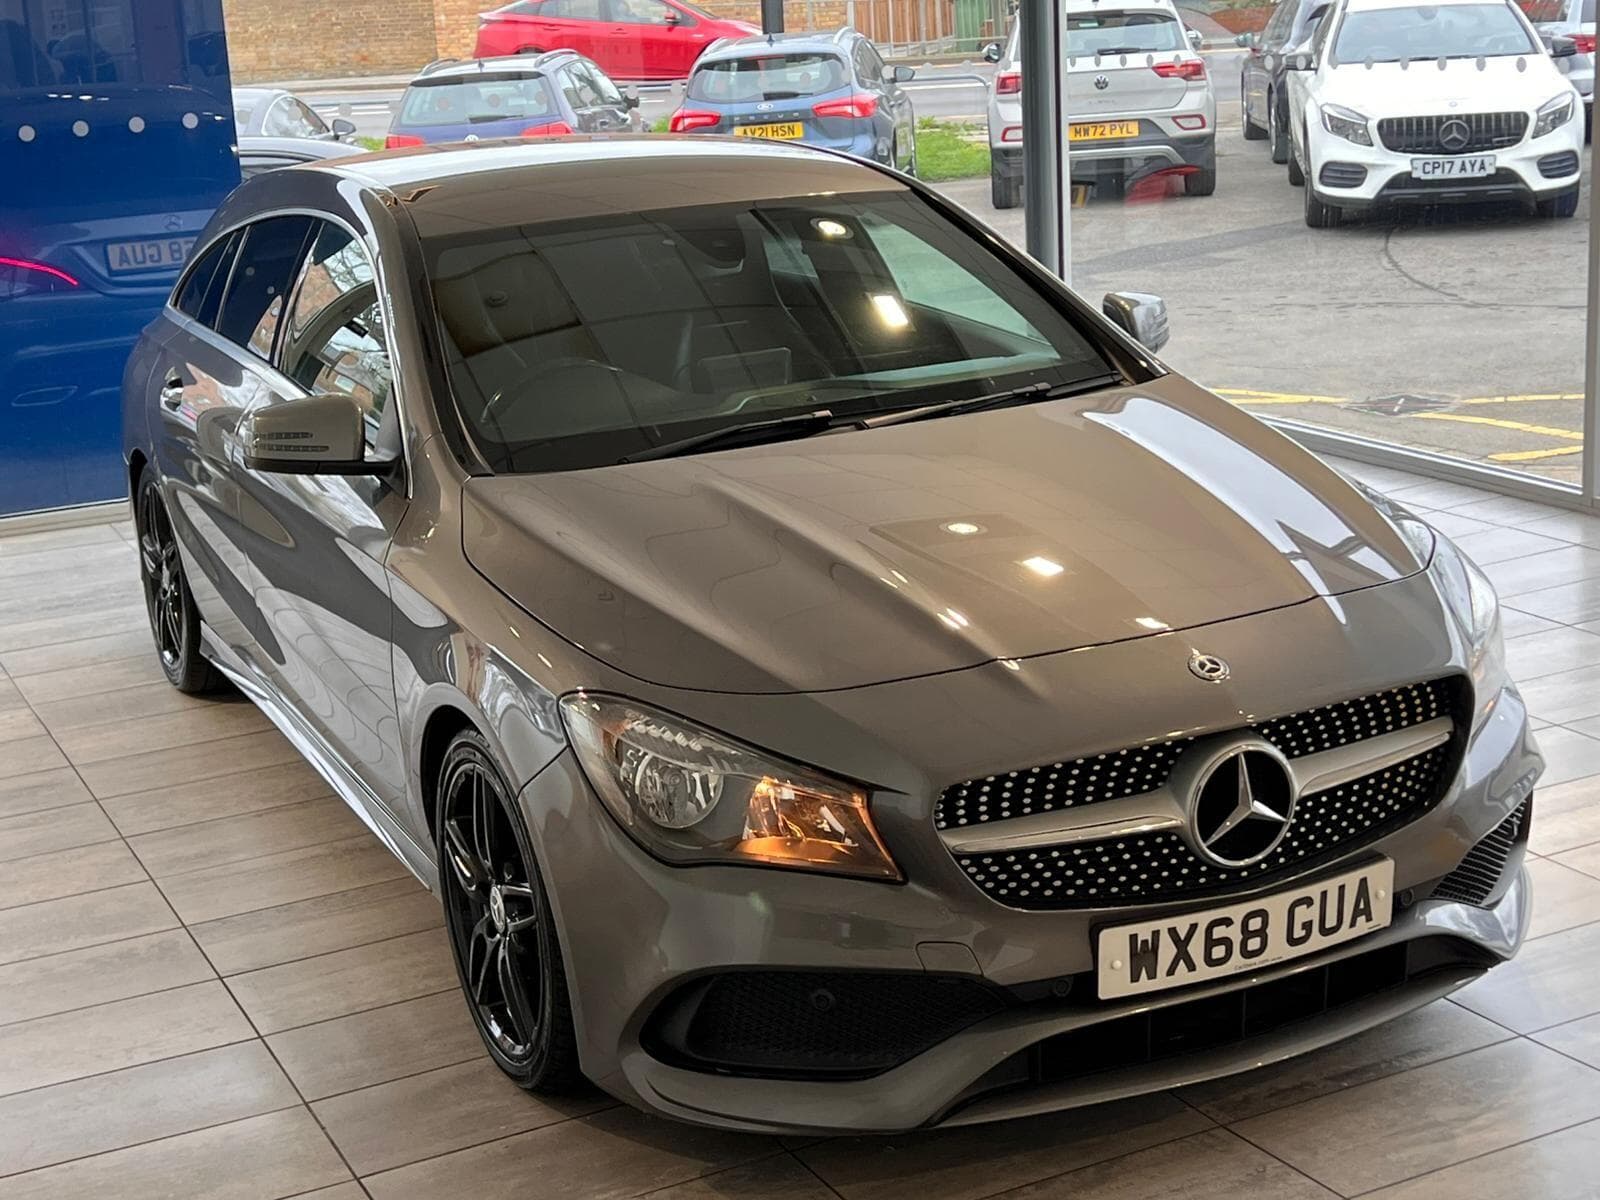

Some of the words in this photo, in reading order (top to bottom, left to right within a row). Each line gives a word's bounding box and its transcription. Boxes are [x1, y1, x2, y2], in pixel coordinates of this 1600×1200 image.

[742, 127, 768, 137] AV21
[771, 126, 795, 137] HSN
[1074, 125, 1105, 137] MW72
[1109, 123, 1133, 135] PYL
[1422, 161, 1455, 175] CP17
[1459, 159, 1487, 174] AYA
[1129, 908, 1269, 984] WX68
[1286, 876, 1373, 948] GUA
